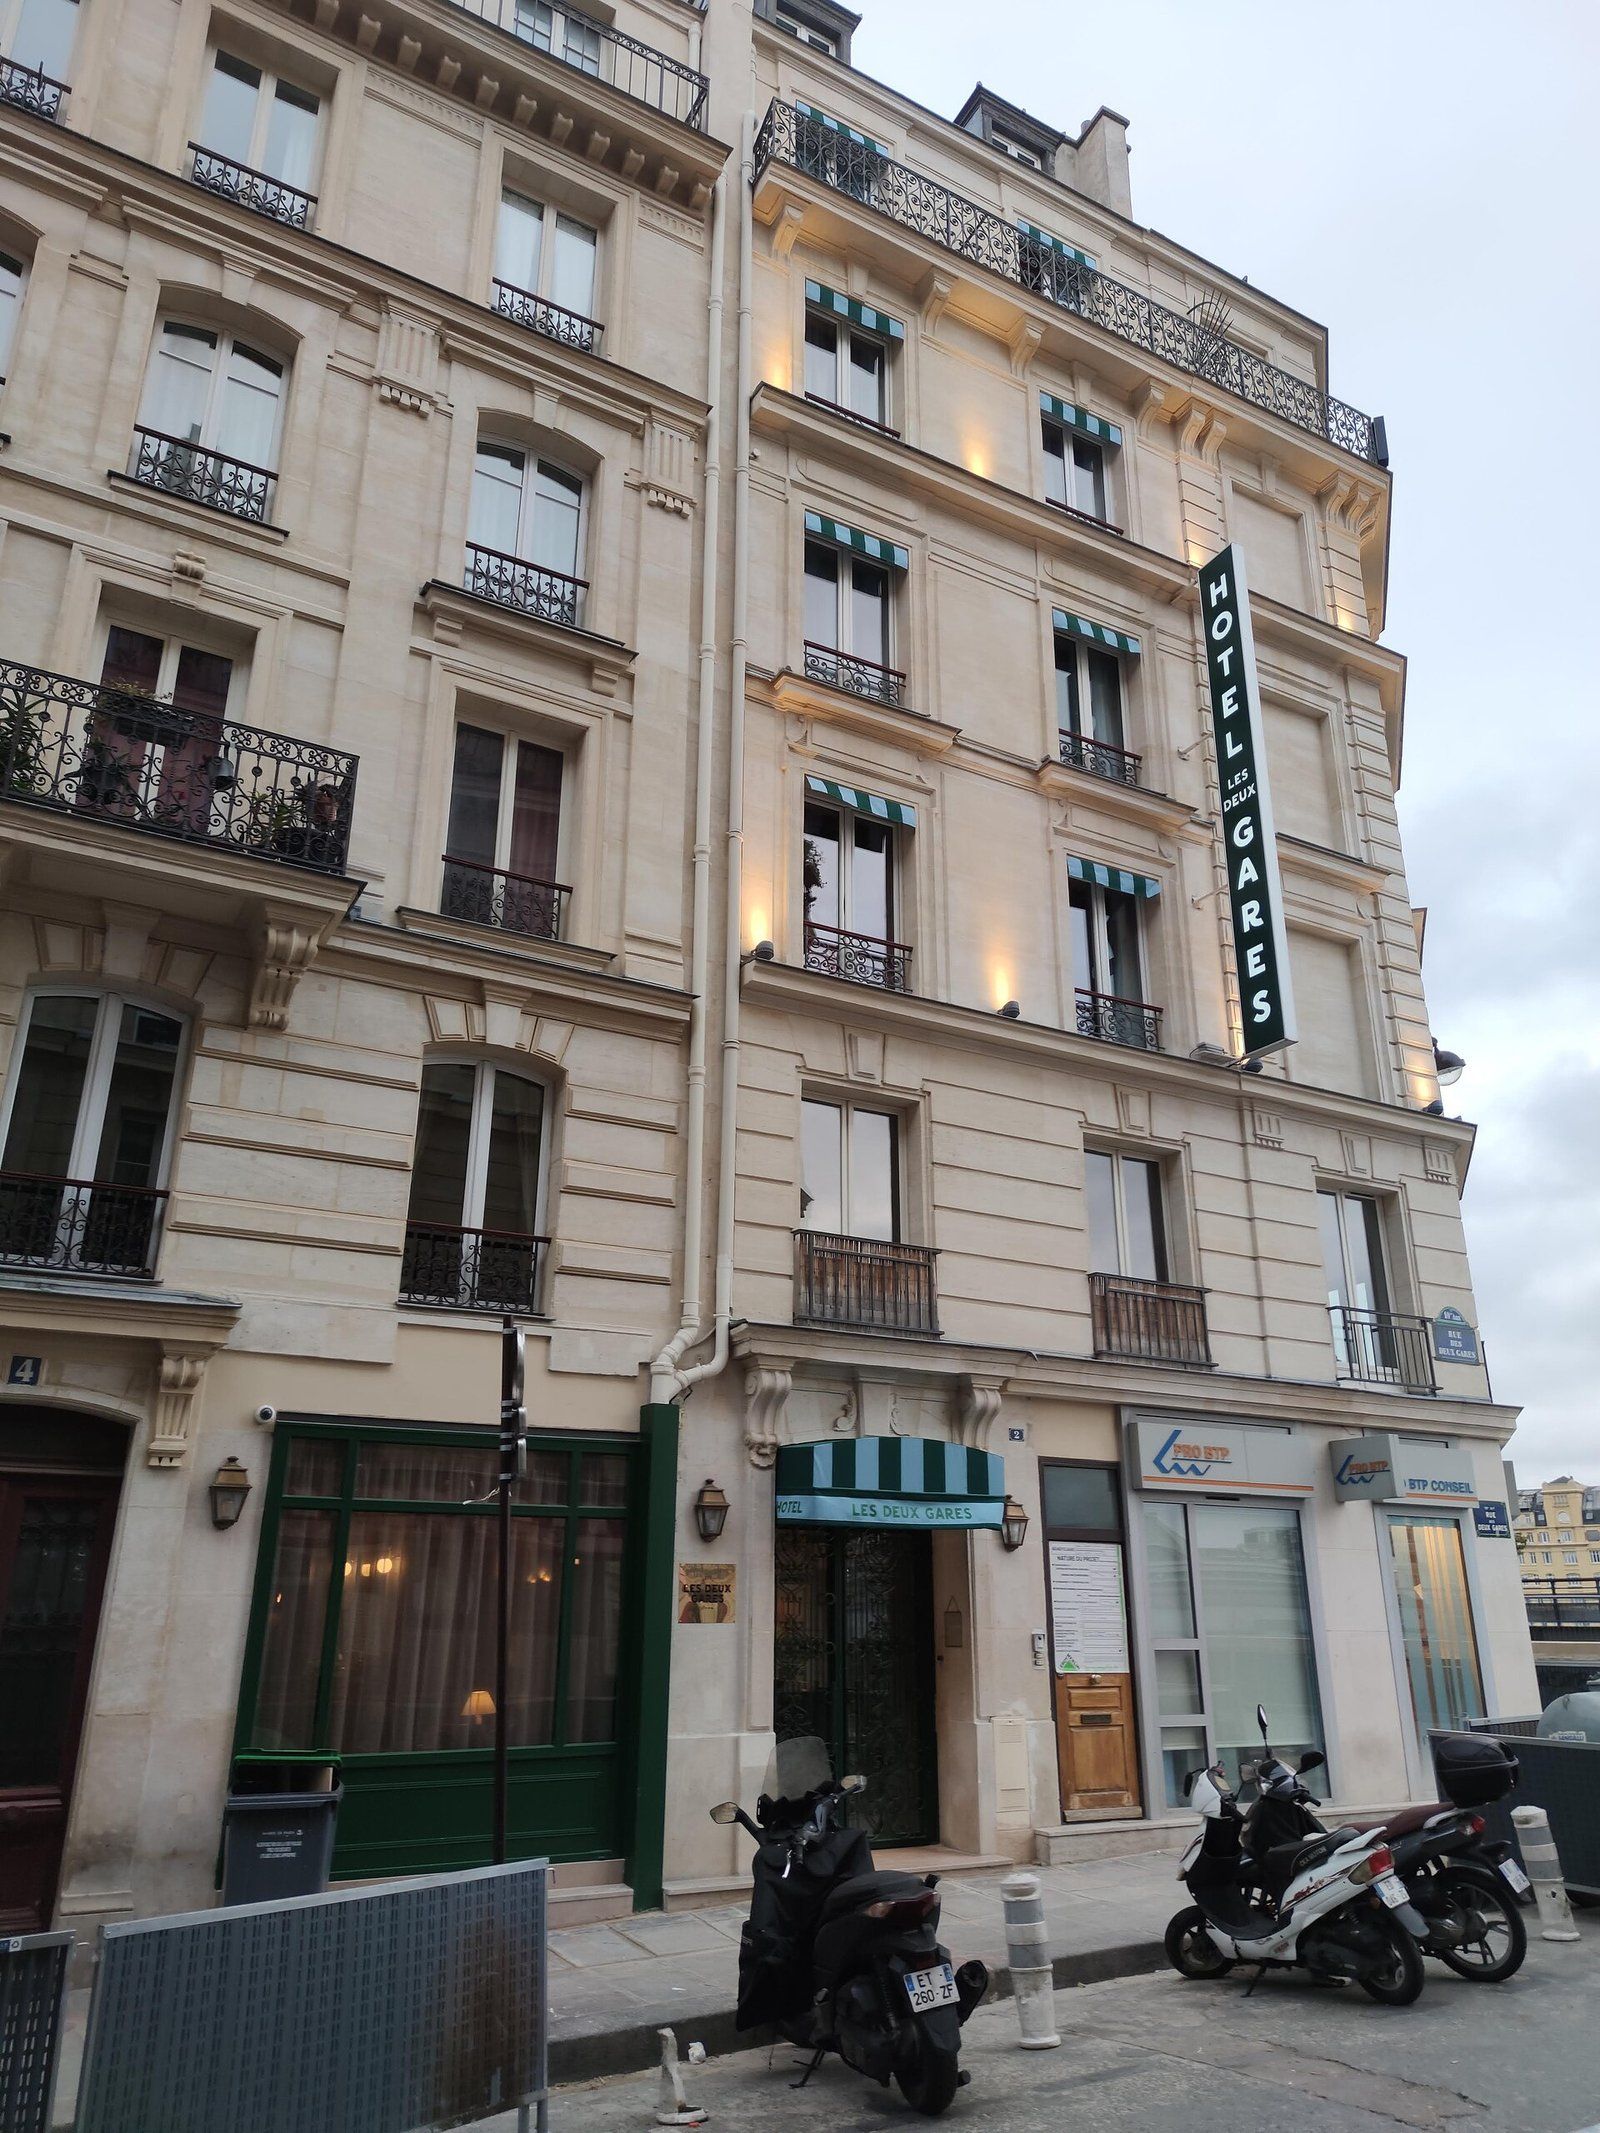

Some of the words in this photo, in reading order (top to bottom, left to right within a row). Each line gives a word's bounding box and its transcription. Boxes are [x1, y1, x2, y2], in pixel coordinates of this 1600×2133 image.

[1209, 572, 1243, 760] HOTEL
[1227, 768, 1249, 791] LES
[1223, 783, 1257, 813] DEUX
[1232, 815, 1272, 1024] GARES
[1447, 1330, 1462, 1339] RUE
[1450, 1339, 1462, 1348] DES
[1438, 1347, 1456, 1356] DEUX
[1455, 1349, 1476, 1359] GARES
[15, 1358, 35, 1382] 4
[1013, 1430, 1020, 1439] 2
[1173, 1443, 1201, 1459] PRO
[1203, 1445, 1231, 1460] BTP
[1348, 1461, 1368, 1472] PRO
[1369, 1460, 1388, 1471] BTP
[1408, 1478, 1429, 1490] BTP
[1431, 1480, 1474, 1494] CONSEIL
[776, 1500, 802, 1514] HOTEL
[852, 1503, 877, 1517] LES
[883, 1504, 920, 1519] DEUX
[925, 1506, 972, 1520] GARES
[1485, 1511, 1496, 1519] RUE
[683, 1583, 702, 1593] LES
[704, 1583, 731, 1593] DEUX
[691, 1594, 724, 1603] GARES
[916, 1971, 932, 1988] ET
